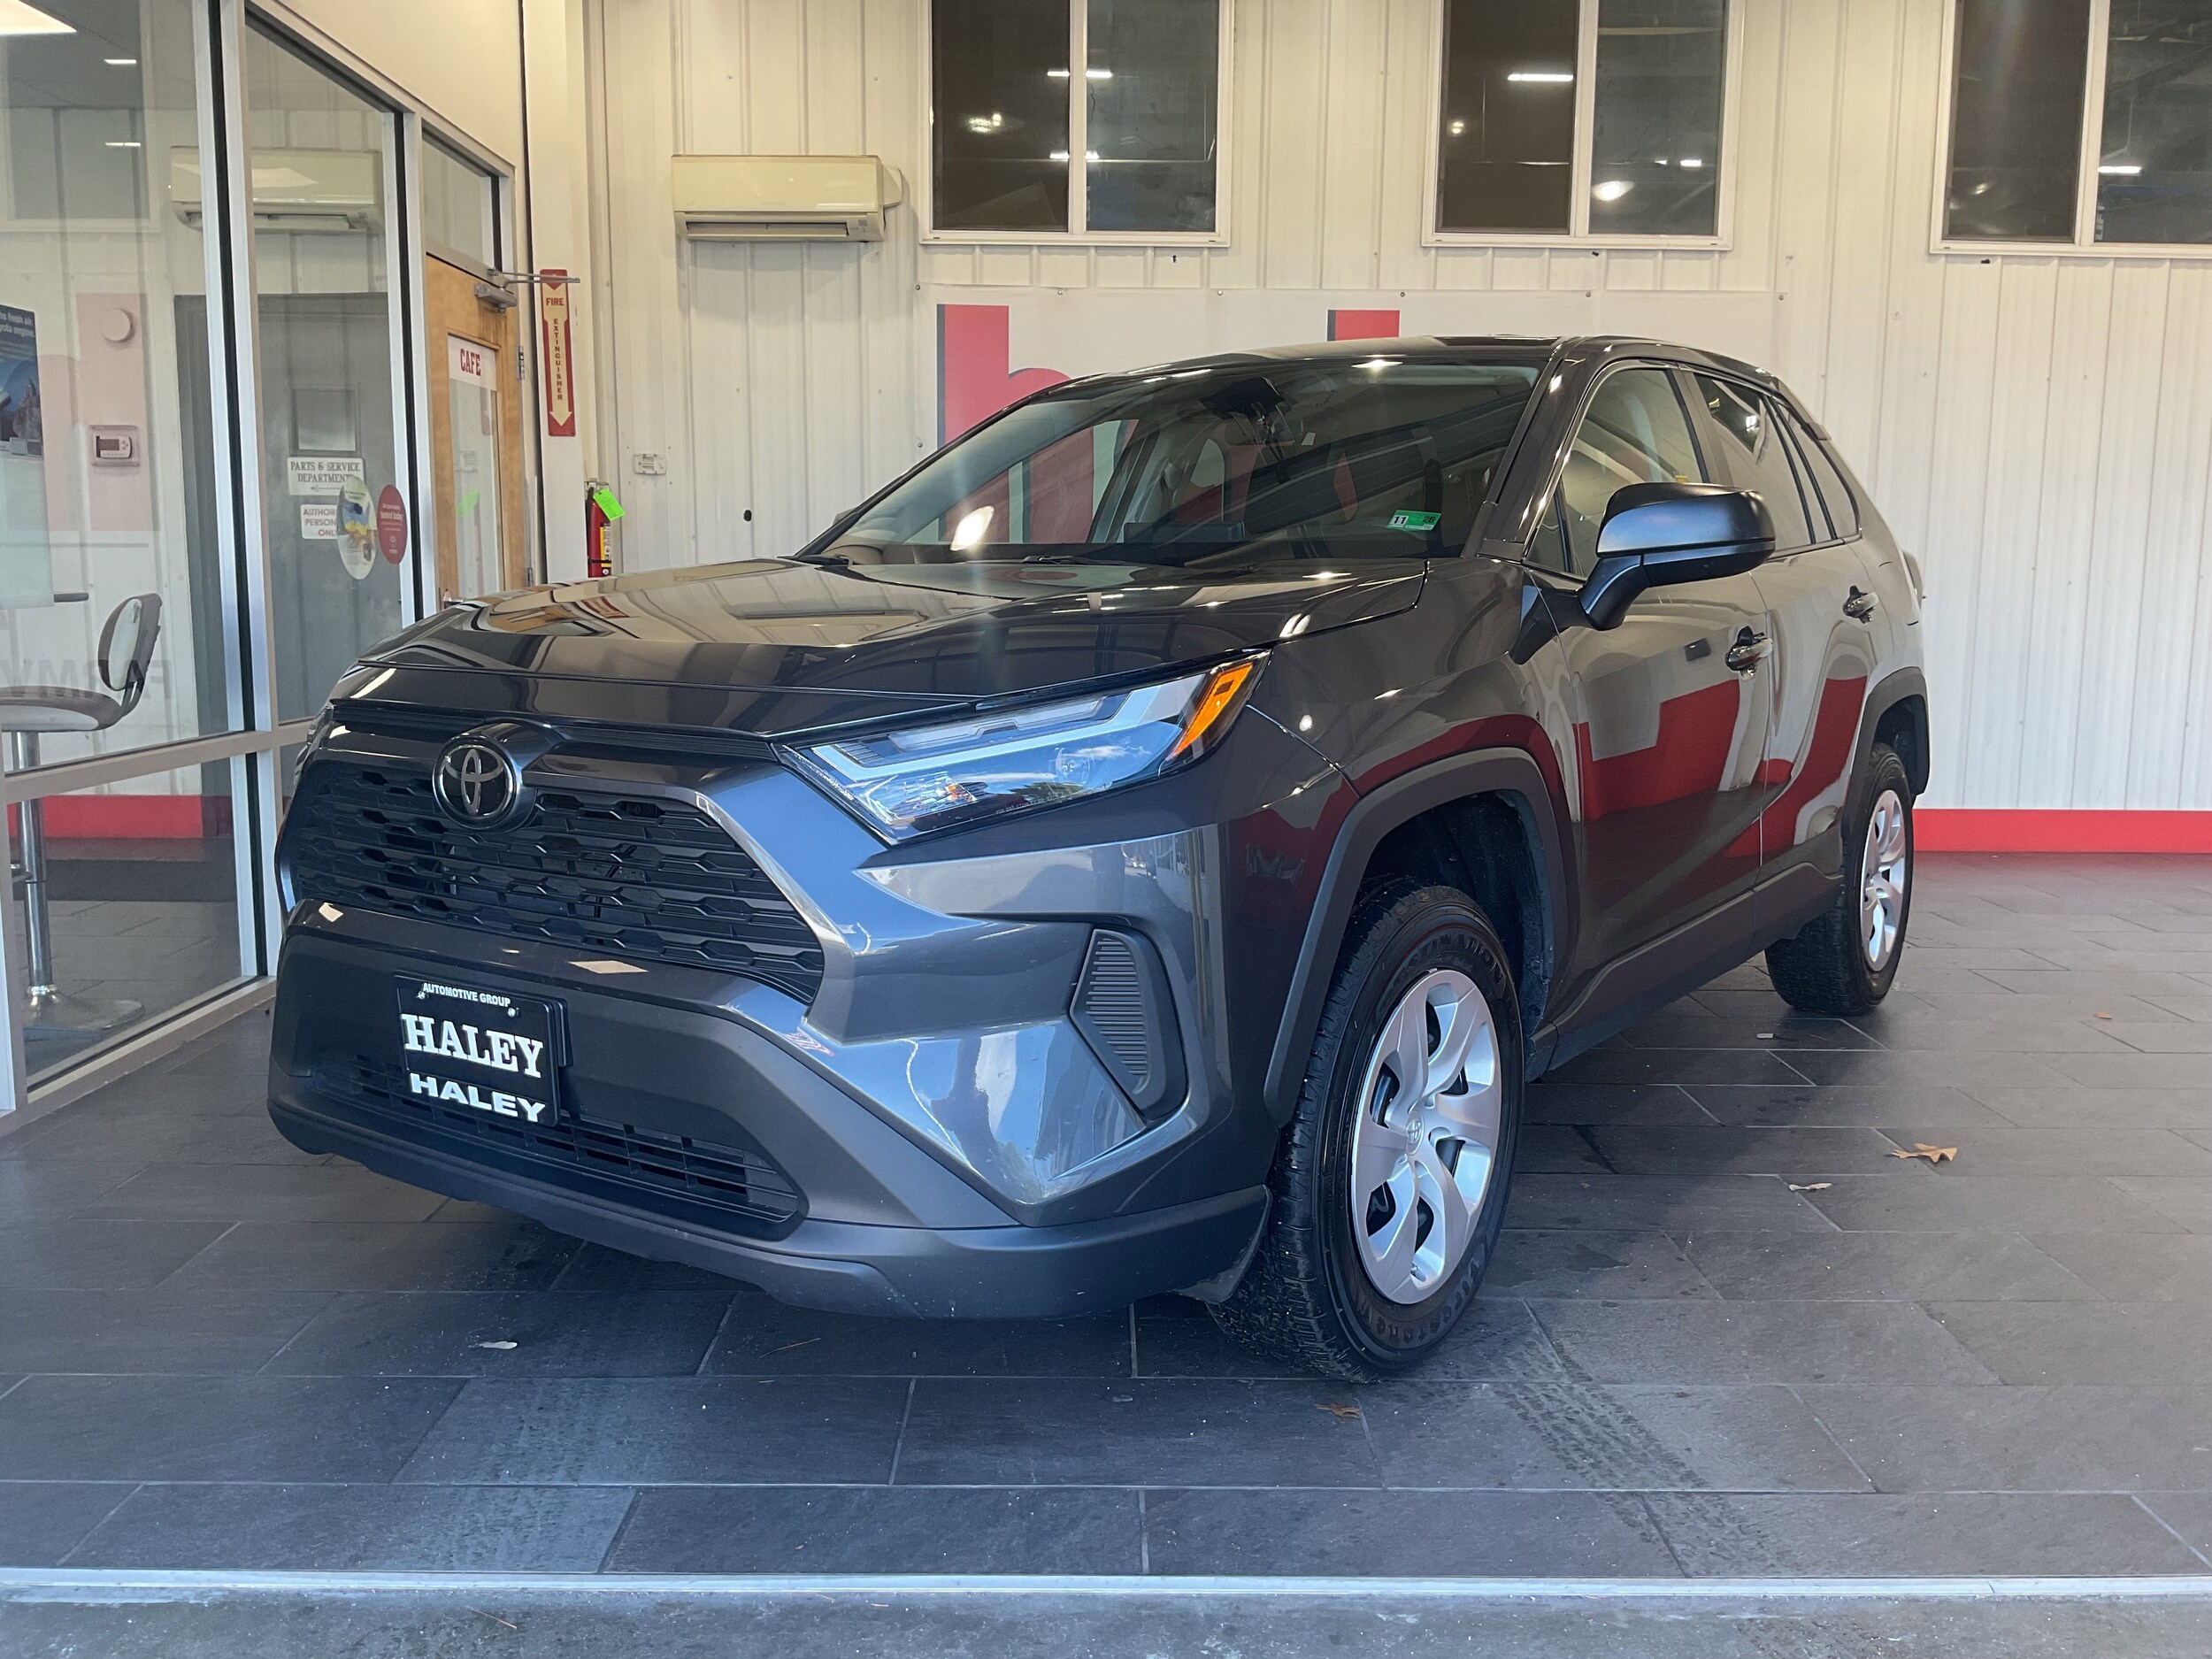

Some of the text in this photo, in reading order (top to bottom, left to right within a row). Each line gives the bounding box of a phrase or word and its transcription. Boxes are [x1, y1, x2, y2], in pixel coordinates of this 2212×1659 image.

[546, 297, 565, 306] FIRE
[460, 348, 481, 376] CAFE
[553, 319, 563, 400] EXTINGUISHER
[290, 461, 360, 472] PARTS & SERVICE
[297, 473, 354, 483] DEPARTMENT
[1394, 516, 1407, 525] 11
[423, 982, 511, 1007] AUTOMOTIVE GROUP
[401, 1014, 544, 1079] HALEY
[410, 1072, 546, 1122] HALEY
